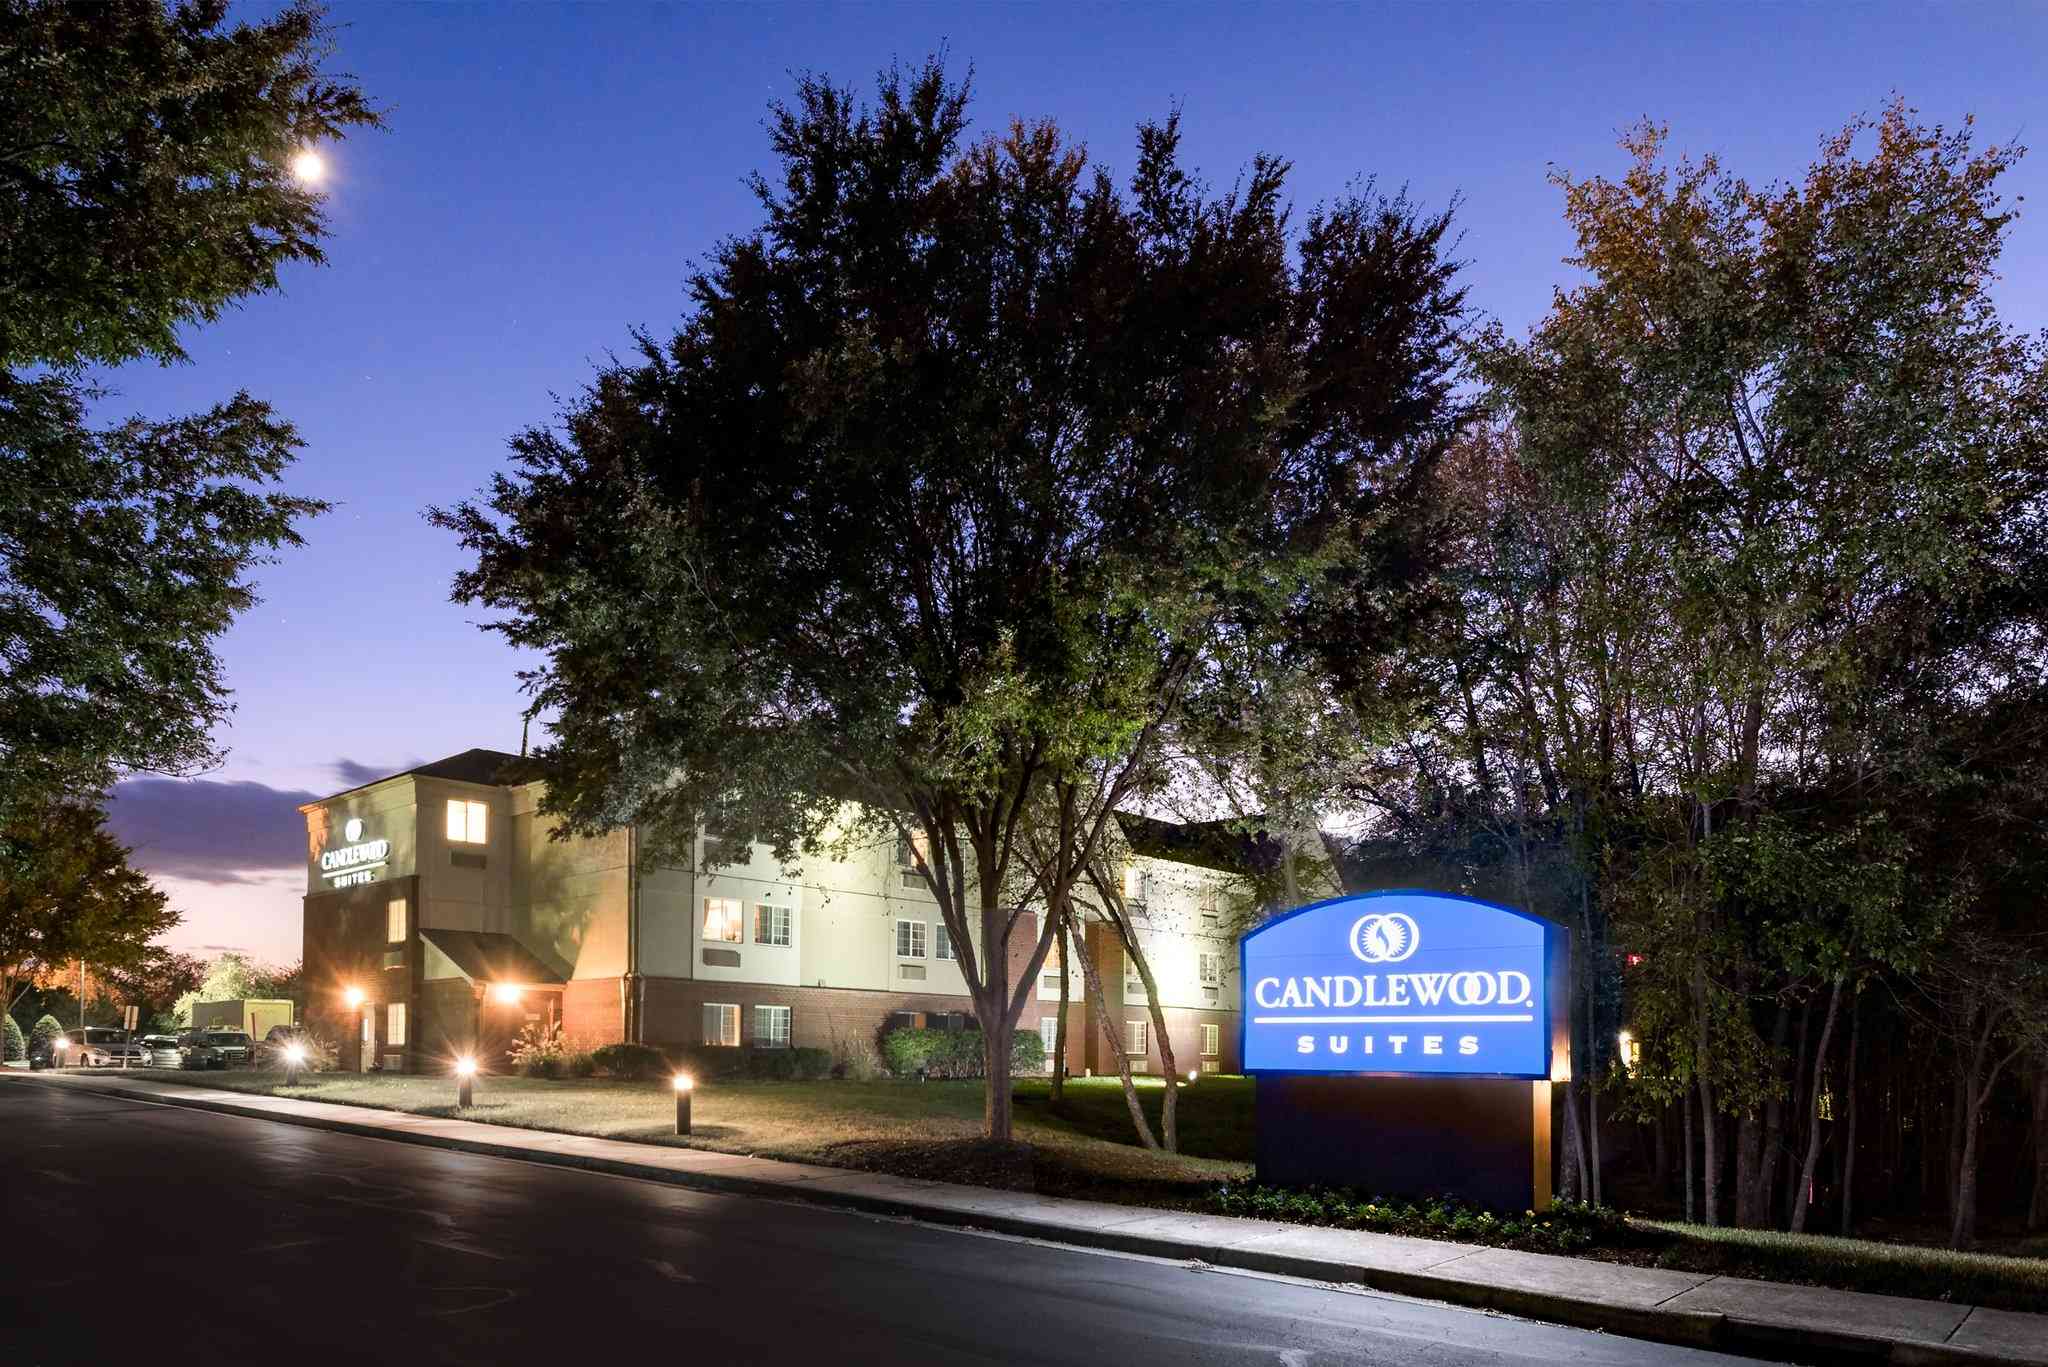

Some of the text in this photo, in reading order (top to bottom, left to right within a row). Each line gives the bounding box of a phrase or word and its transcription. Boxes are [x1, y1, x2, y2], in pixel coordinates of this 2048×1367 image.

[321, 840, 387, 870] CANDLEWOOD
[333, 870, 373, 888] SUITES
[1255, 971, 1532, 1008] CANDLEWOOD
[1298, 1035, 1479, 1055] SUITES
